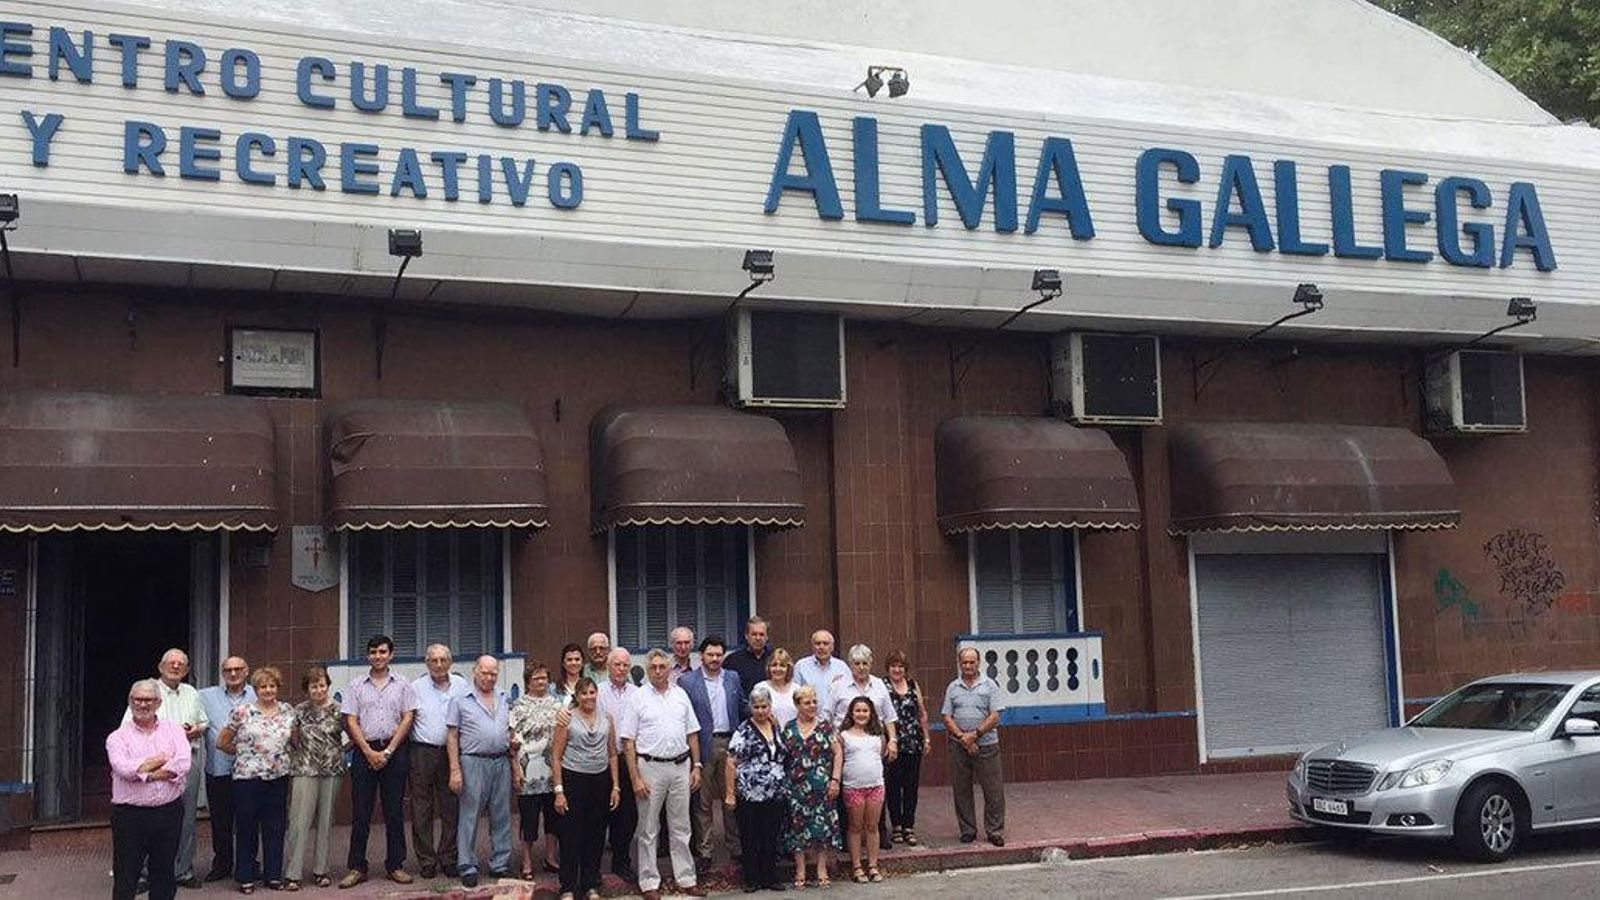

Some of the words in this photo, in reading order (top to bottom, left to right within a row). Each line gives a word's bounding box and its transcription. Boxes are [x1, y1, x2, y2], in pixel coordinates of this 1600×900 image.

[0, 22, 261, 100] ENTRO
[296, 56, 660, 143] CULTURAL
[21, 111, 64, 168] Y
[123, 120, 584, 211] RECREATIVO
[764, 108, 1097, 241] ALMA
[1135, 147, 1557, 272] GALLEGA
